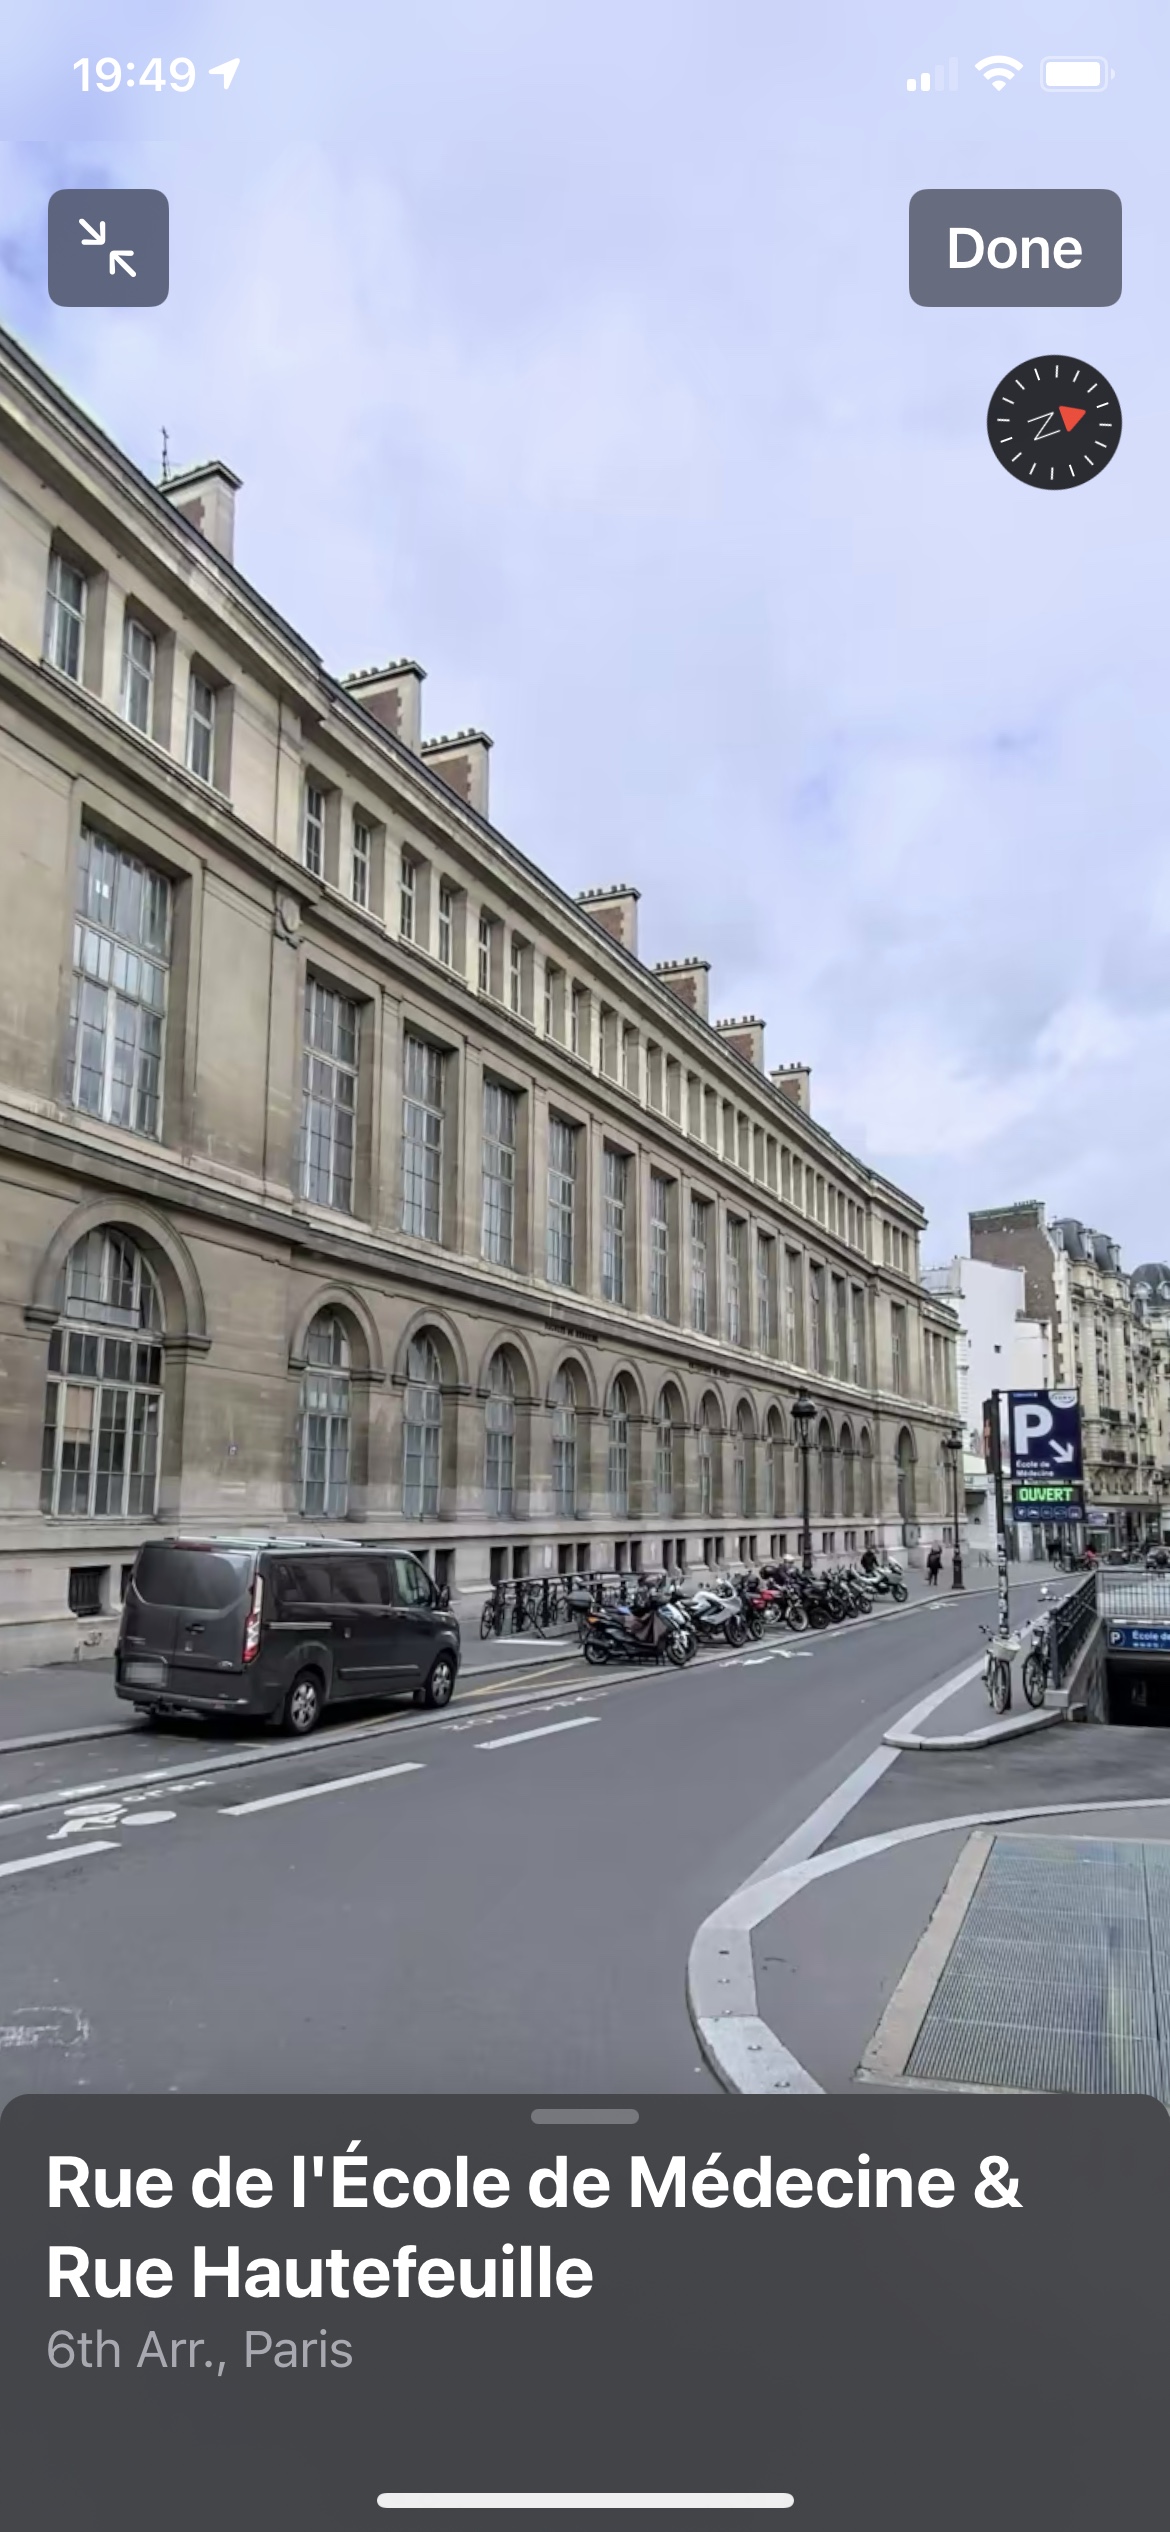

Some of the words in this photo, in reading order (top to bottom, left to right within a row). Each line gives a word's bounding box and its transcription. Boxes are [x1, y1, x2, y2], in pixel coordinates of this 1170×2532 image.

[1014, 1404, 1053, 1455] P
[1016, 1459, 1038, 1468] École
[1016, 1469, 1054, 1477] Médecine
[1020, 1487, 1073, 1501] OUVERT
[1110, 1631, 1121, 1644] P
[1132, 1630, 1159, 1641] École
